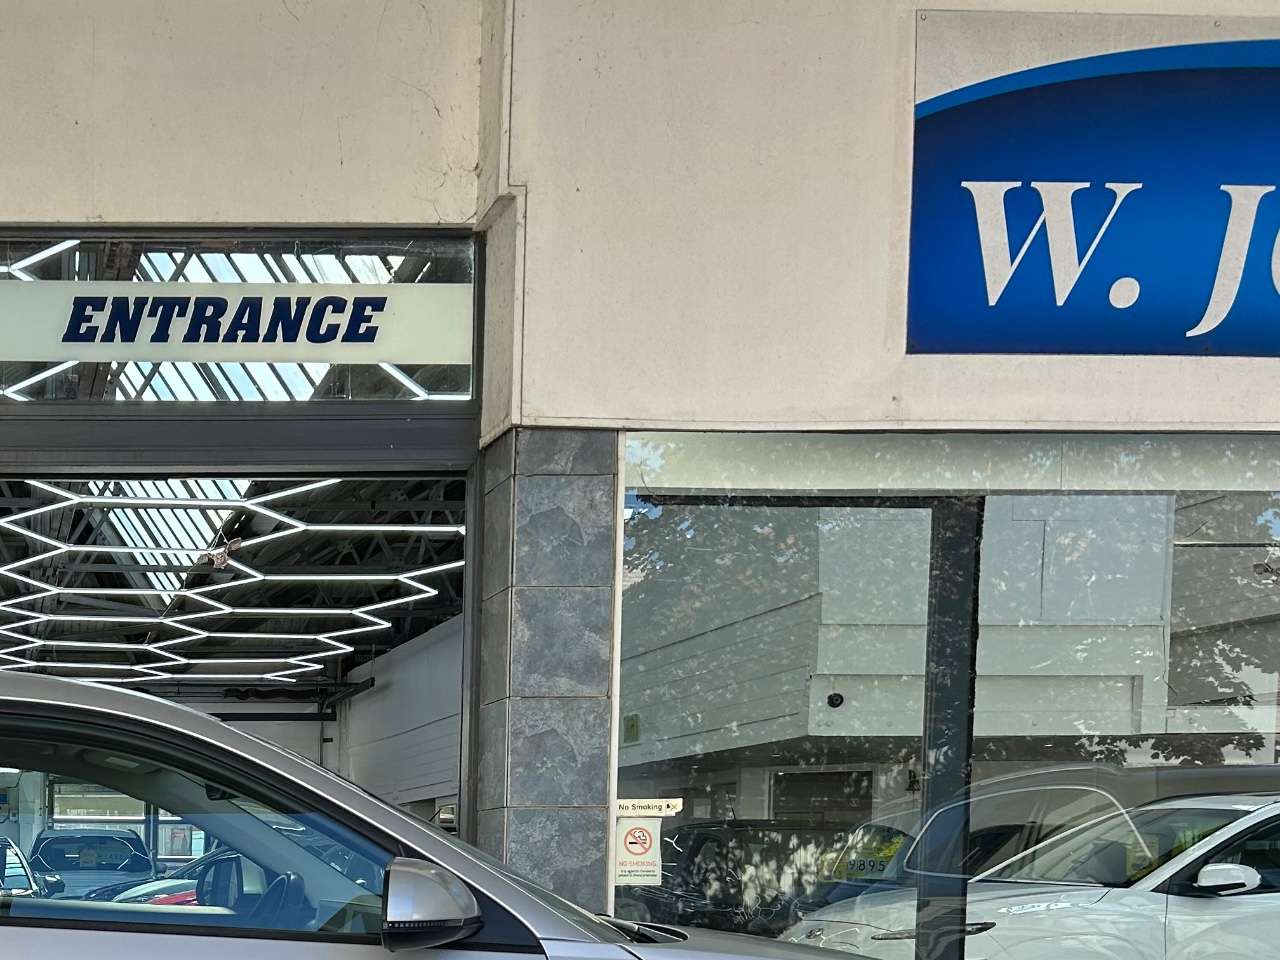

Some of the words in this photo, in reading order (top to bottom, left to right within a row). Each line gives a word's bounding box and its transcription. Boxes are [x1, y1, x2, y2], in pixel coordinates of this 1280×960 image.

[960, 181, 1143, 309] W.
[1185, 184, 1280, 337] J
[61, 295, 388, 344] ENTRANCE
[618, 803, 630, 811] No
[631, 803, 663, 812] Smoking
